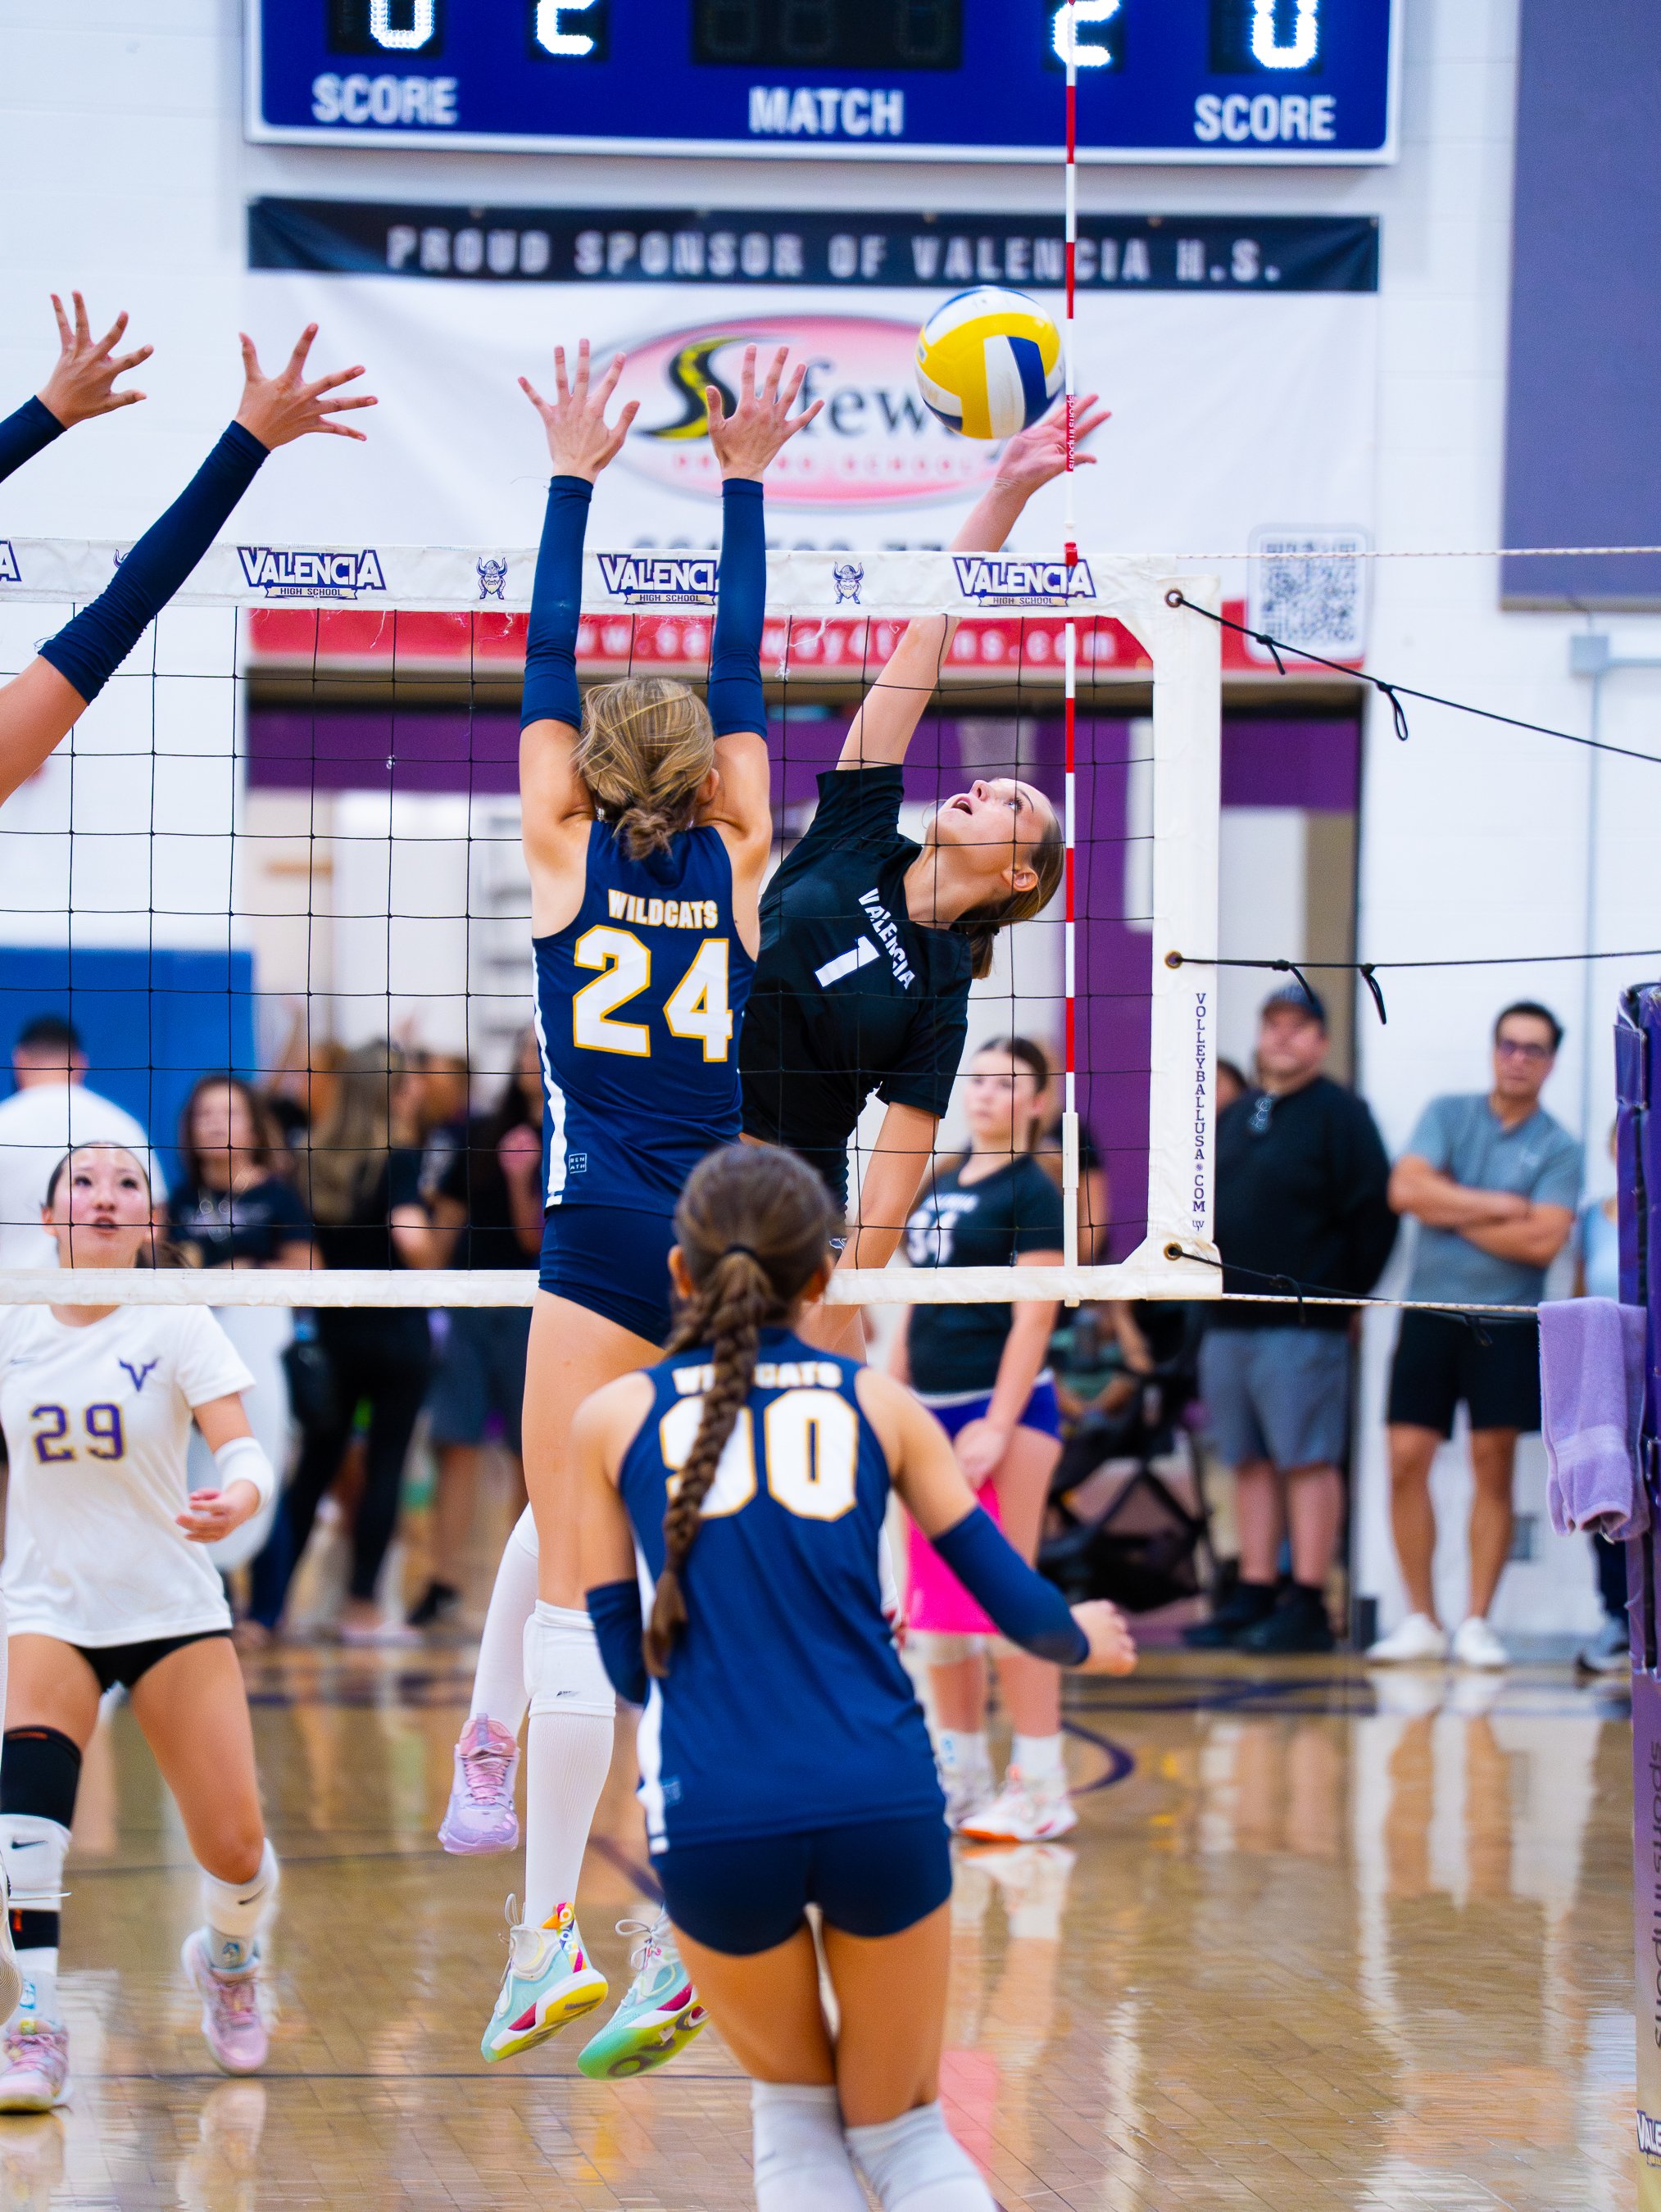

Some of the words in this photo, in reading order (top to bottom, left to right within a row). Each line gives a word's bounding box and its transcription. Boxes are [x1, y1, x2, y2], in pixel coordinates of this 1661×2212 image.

[312, 74, 459, 125] SCORE
[749, 86, 905, 136] MATCH
[1194, 93, 1337, 142] SCORE
[387, 225, 551, 274] PROUD
[574, 229, 804, 279] SPONSOR
[828, 233, 887, 279] OF
[911, 235, 1150, 283] VALENCIA
[1176, 237, 1282, 283] H.S.
[237, 546, 387, 590] VALENCIA
[279, 587, 302, 596] HIGH
[307, 588, 343, 596] SCHOOL
[597, 554, 718, 595] VALENCI
[952, 556, 1096, 599] VALENCIA
[639, 594, 661, 602] HIGH
[665, 594, 701, 603] SCHOOL
[992, 596, 1014, 605] HIGH
[1019, 596, 1054, 605] SCHOOL
[607, 889, 719, 929] WILDCATS
[815, 935, 881, 988] 1
[858, 887, 916, 990] VALENCIA
[573, 924, 734, 1063] 24
[672, 1361, 842, 1395] WICATS
[28, 1399, 128, 1466] 29
[659, 1388, 860, 1522] 90
